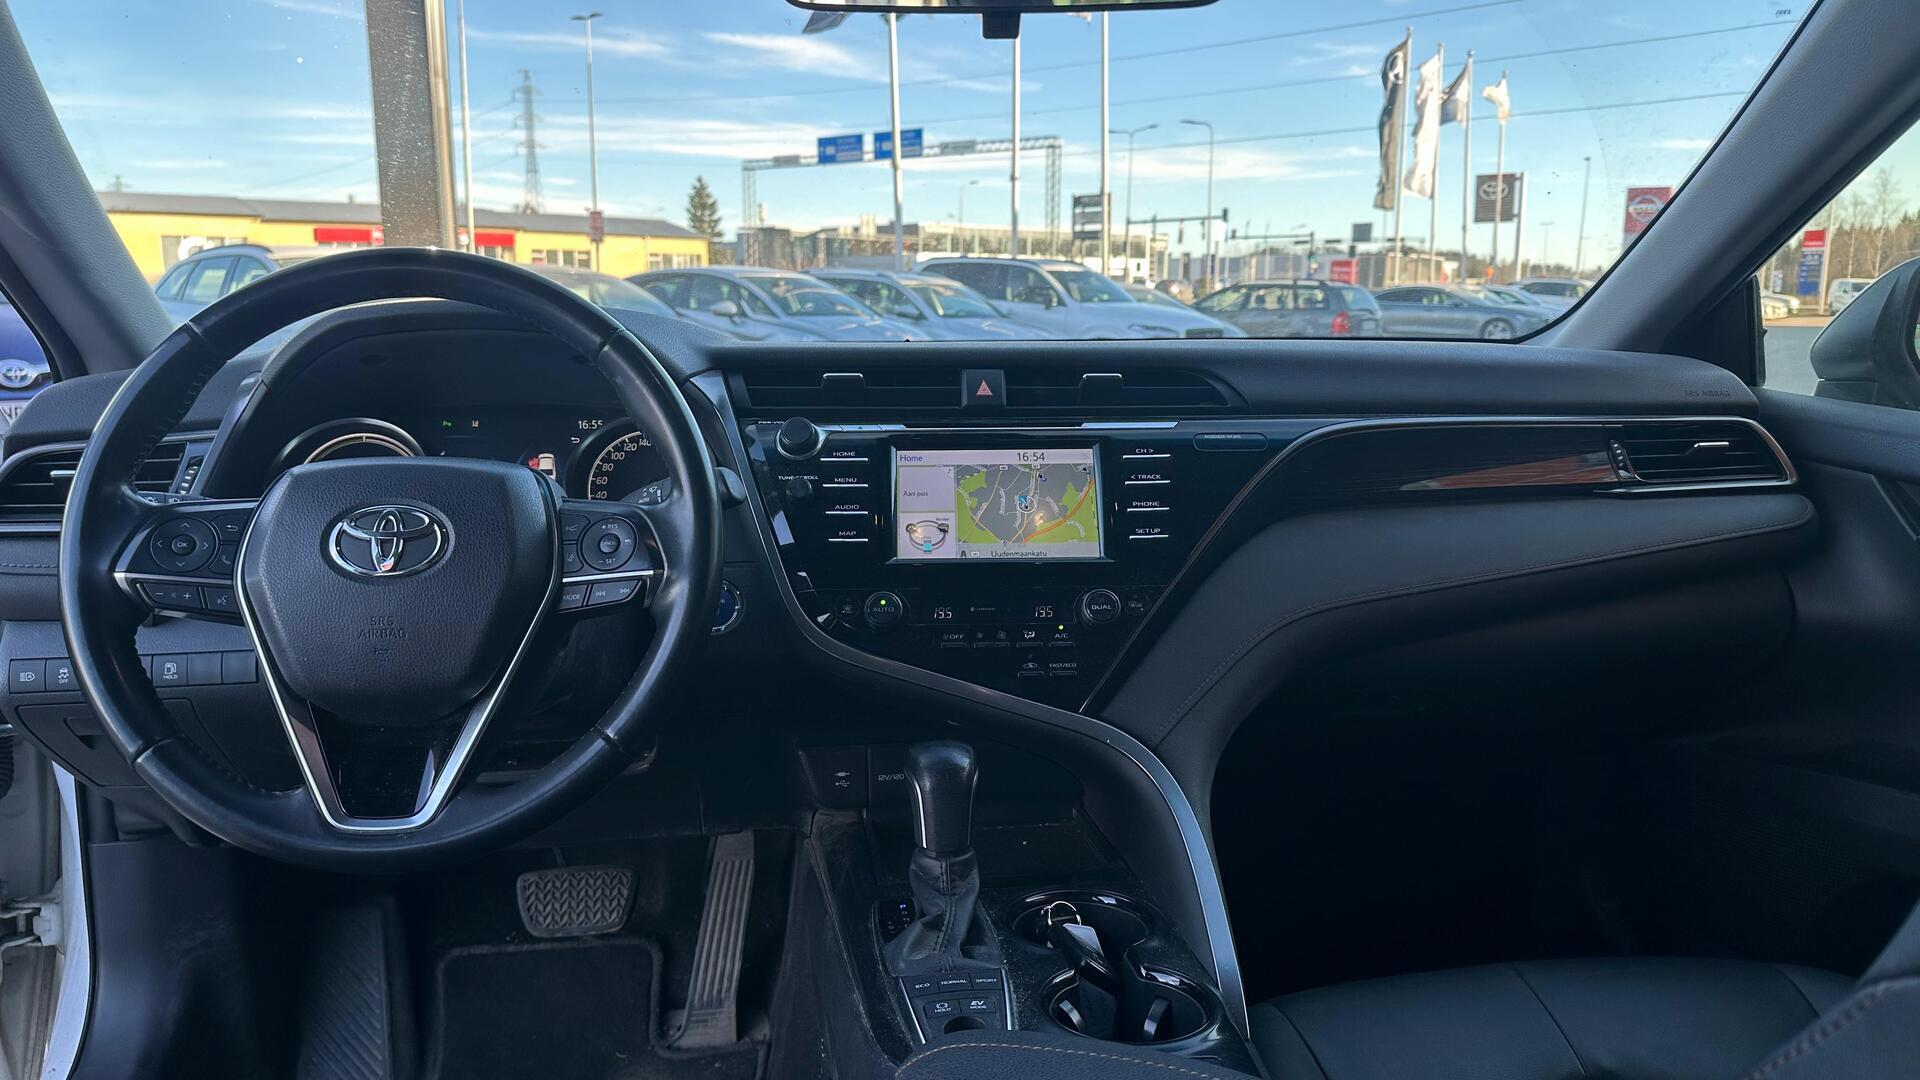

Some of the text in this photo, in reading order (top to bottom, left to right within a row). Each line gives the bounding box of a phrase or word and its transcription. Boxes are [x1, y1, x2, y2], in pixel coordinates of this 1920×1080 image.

[578, 420, 603, 430] 16:55
[623, 443, 637, 452] 120
[611, 452, 625, 460] 100
[900, 454, 924, 462] Home
[1017, 452, 1045, 462] 16:54
[602, 463, 613, 471] 80
[596, 476, 607, 485] 60
[596, 490, 607, 499] 40
[991, 550, 1048, 558] Uudenmaankatu
[370, 615, 393, 626] SRS
[358, 627, 407, 639] AIRBAG
